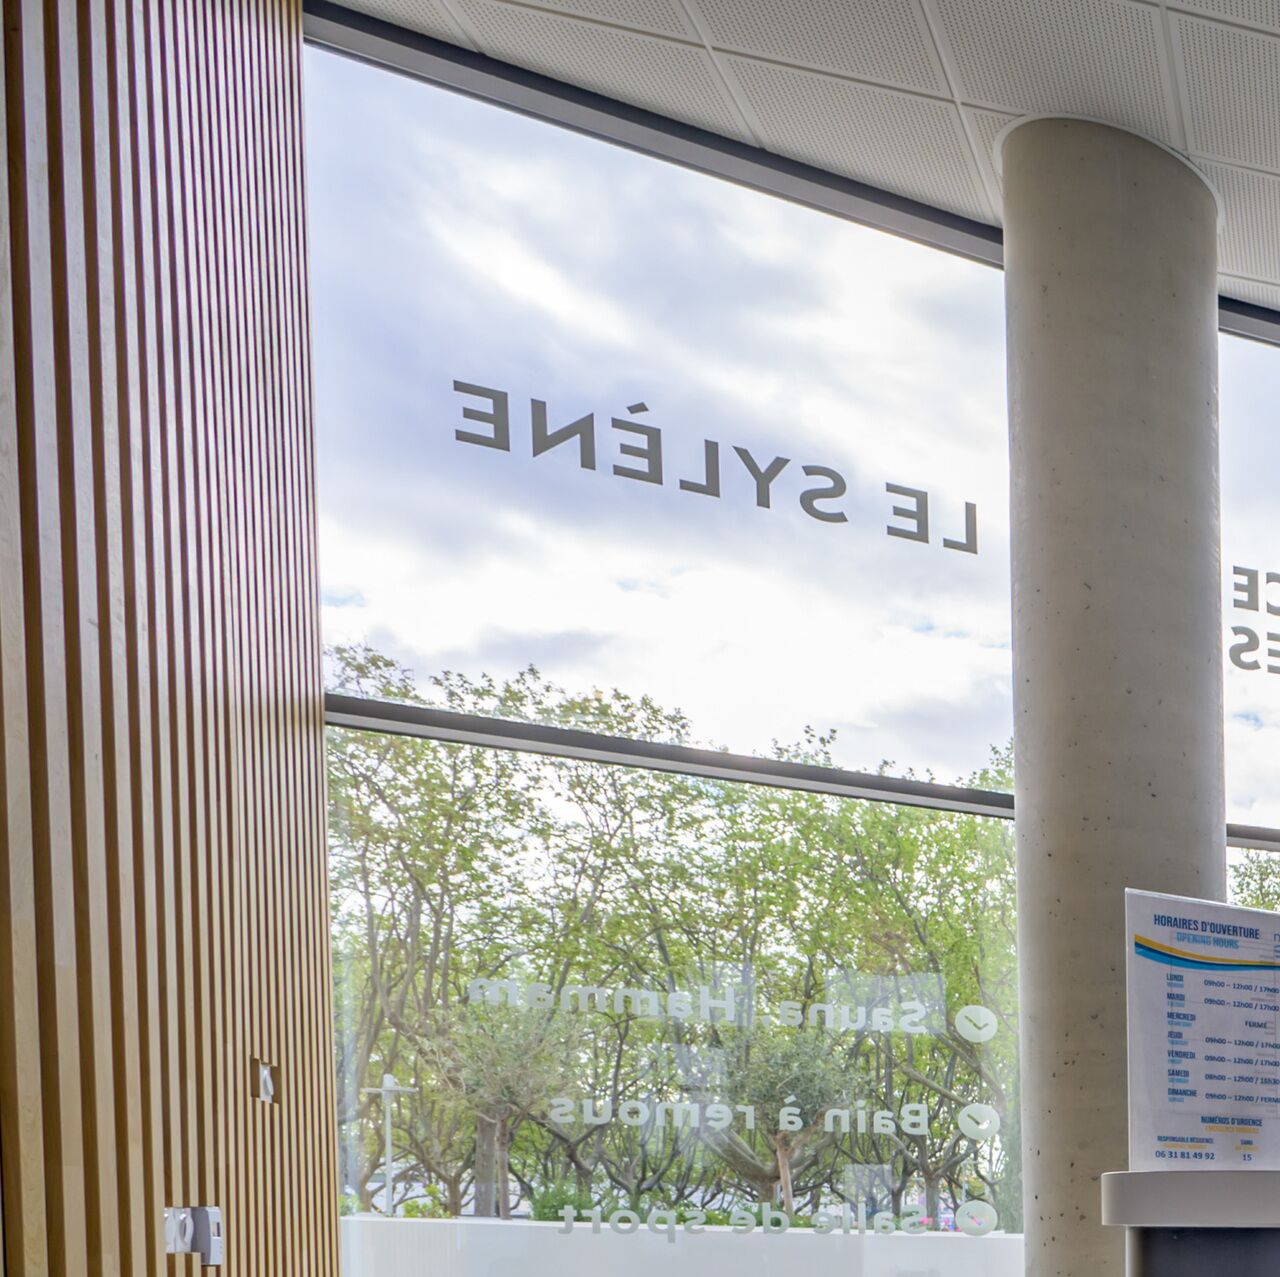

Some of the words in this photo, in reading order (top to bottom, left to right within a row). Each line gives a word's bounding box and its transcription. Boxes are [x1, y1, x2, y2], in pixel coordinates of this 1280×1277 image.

[1153, 914, 1199, 932] HORAIRES
[1200, 920, 1260, 940] D'OUVERTURE
[1166, 973, 1184, 982] LUNDI
[1155, 1150, 1167, 1159] 06
[1168, 1150, 1178, 1159] 31
[1180, 1151, 1190, 1160] 81
[1192, 1152, 1203, 1160] 49
[1204, 1152, 1216, 1161] 92
[1242, 1154, 1253, 1162] 15
